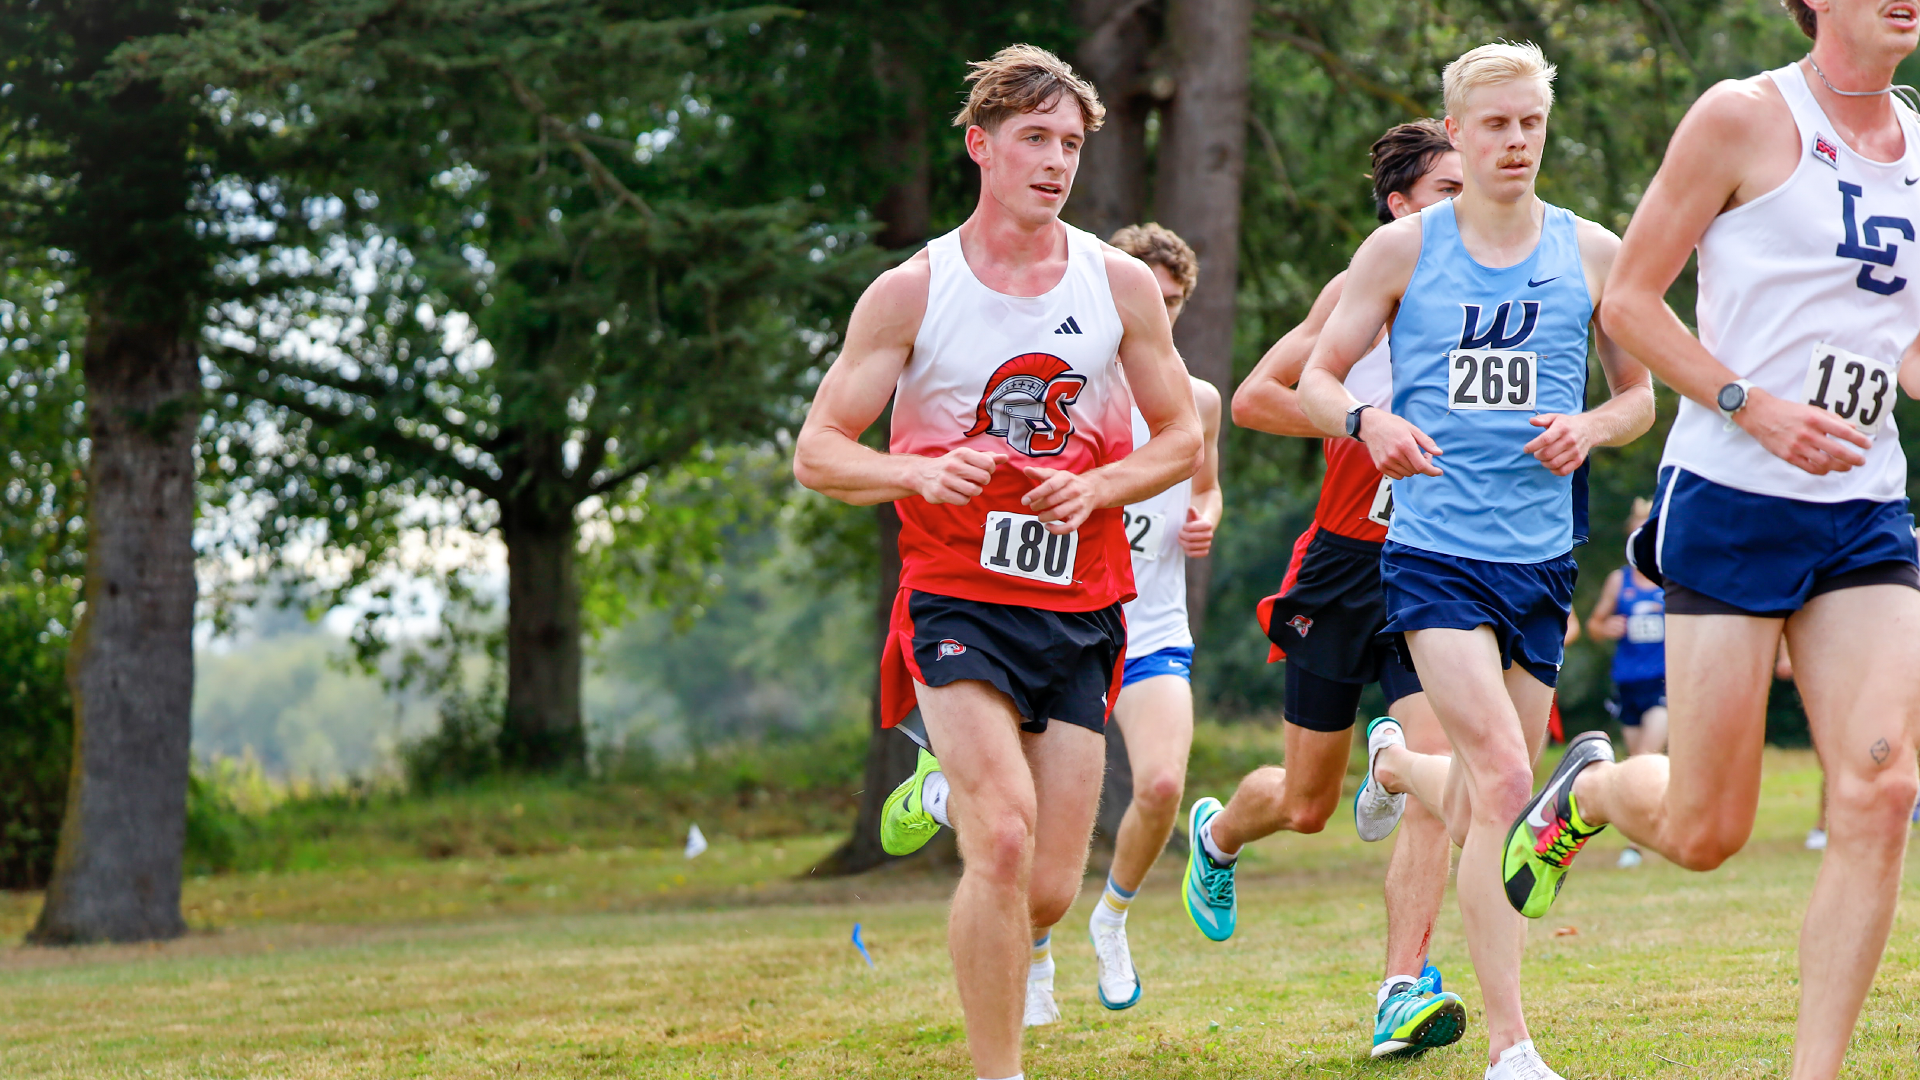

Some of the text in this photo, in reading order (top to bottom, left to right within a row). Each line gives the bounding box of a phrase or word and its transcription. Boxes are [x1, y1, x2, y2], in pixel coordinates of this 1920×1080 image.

[1836, 179, 1916, 295] LC
[1458, 300, 1542, 350] W
[1453, 355, 1531, 405] 269
[1808, 354, 1889, 426] 133
[989, 517, 1071, 578] 180
